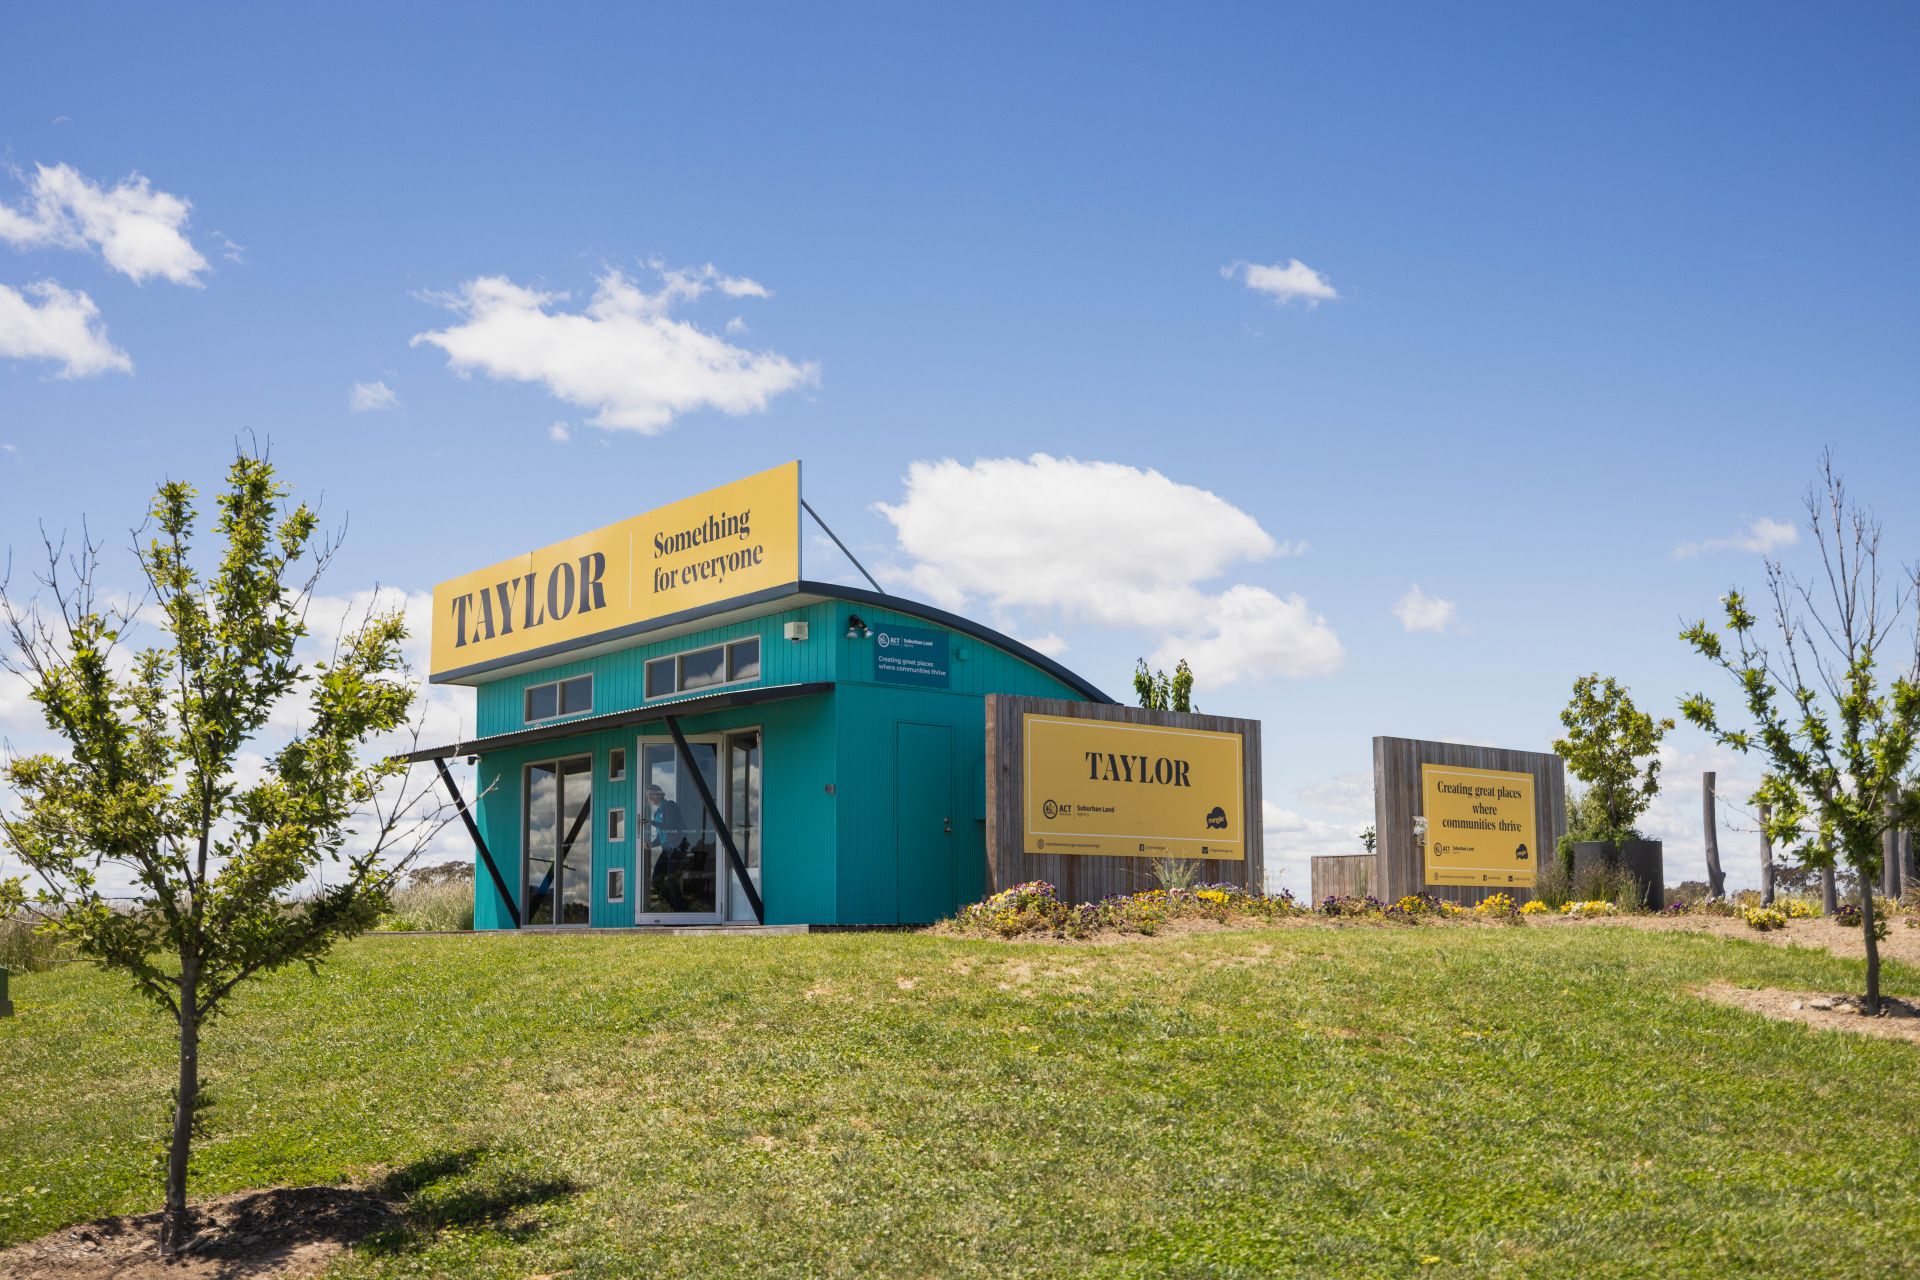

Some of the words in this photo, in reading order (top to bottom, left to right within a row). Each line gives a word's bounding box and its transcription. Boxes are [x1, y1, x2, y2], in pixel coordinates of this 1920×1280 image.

[654, 508, 751, 558] Something
[653, 569, 679, 593] for
[682, 545, 763, 583] everyone
[452, 551, 607, 648] TAYLOR
[879, 656, 901, 665] Creating
[917, 660, 933, 668] places
[897, 667, 930, 675] communities
[1085, 752, 1191, 787] TAYLOR
[1437, 781, 1473, 798] Creating
[1475, 786, 1495, 799] great
[1497, 787, 1522, 800] places
[1060, 804, 1072, 812] ACT
[1472, 802, 1497, 815] where
[1442, 819, 1496, 831] communities
[1499, 820, 1522, 832] thrive
